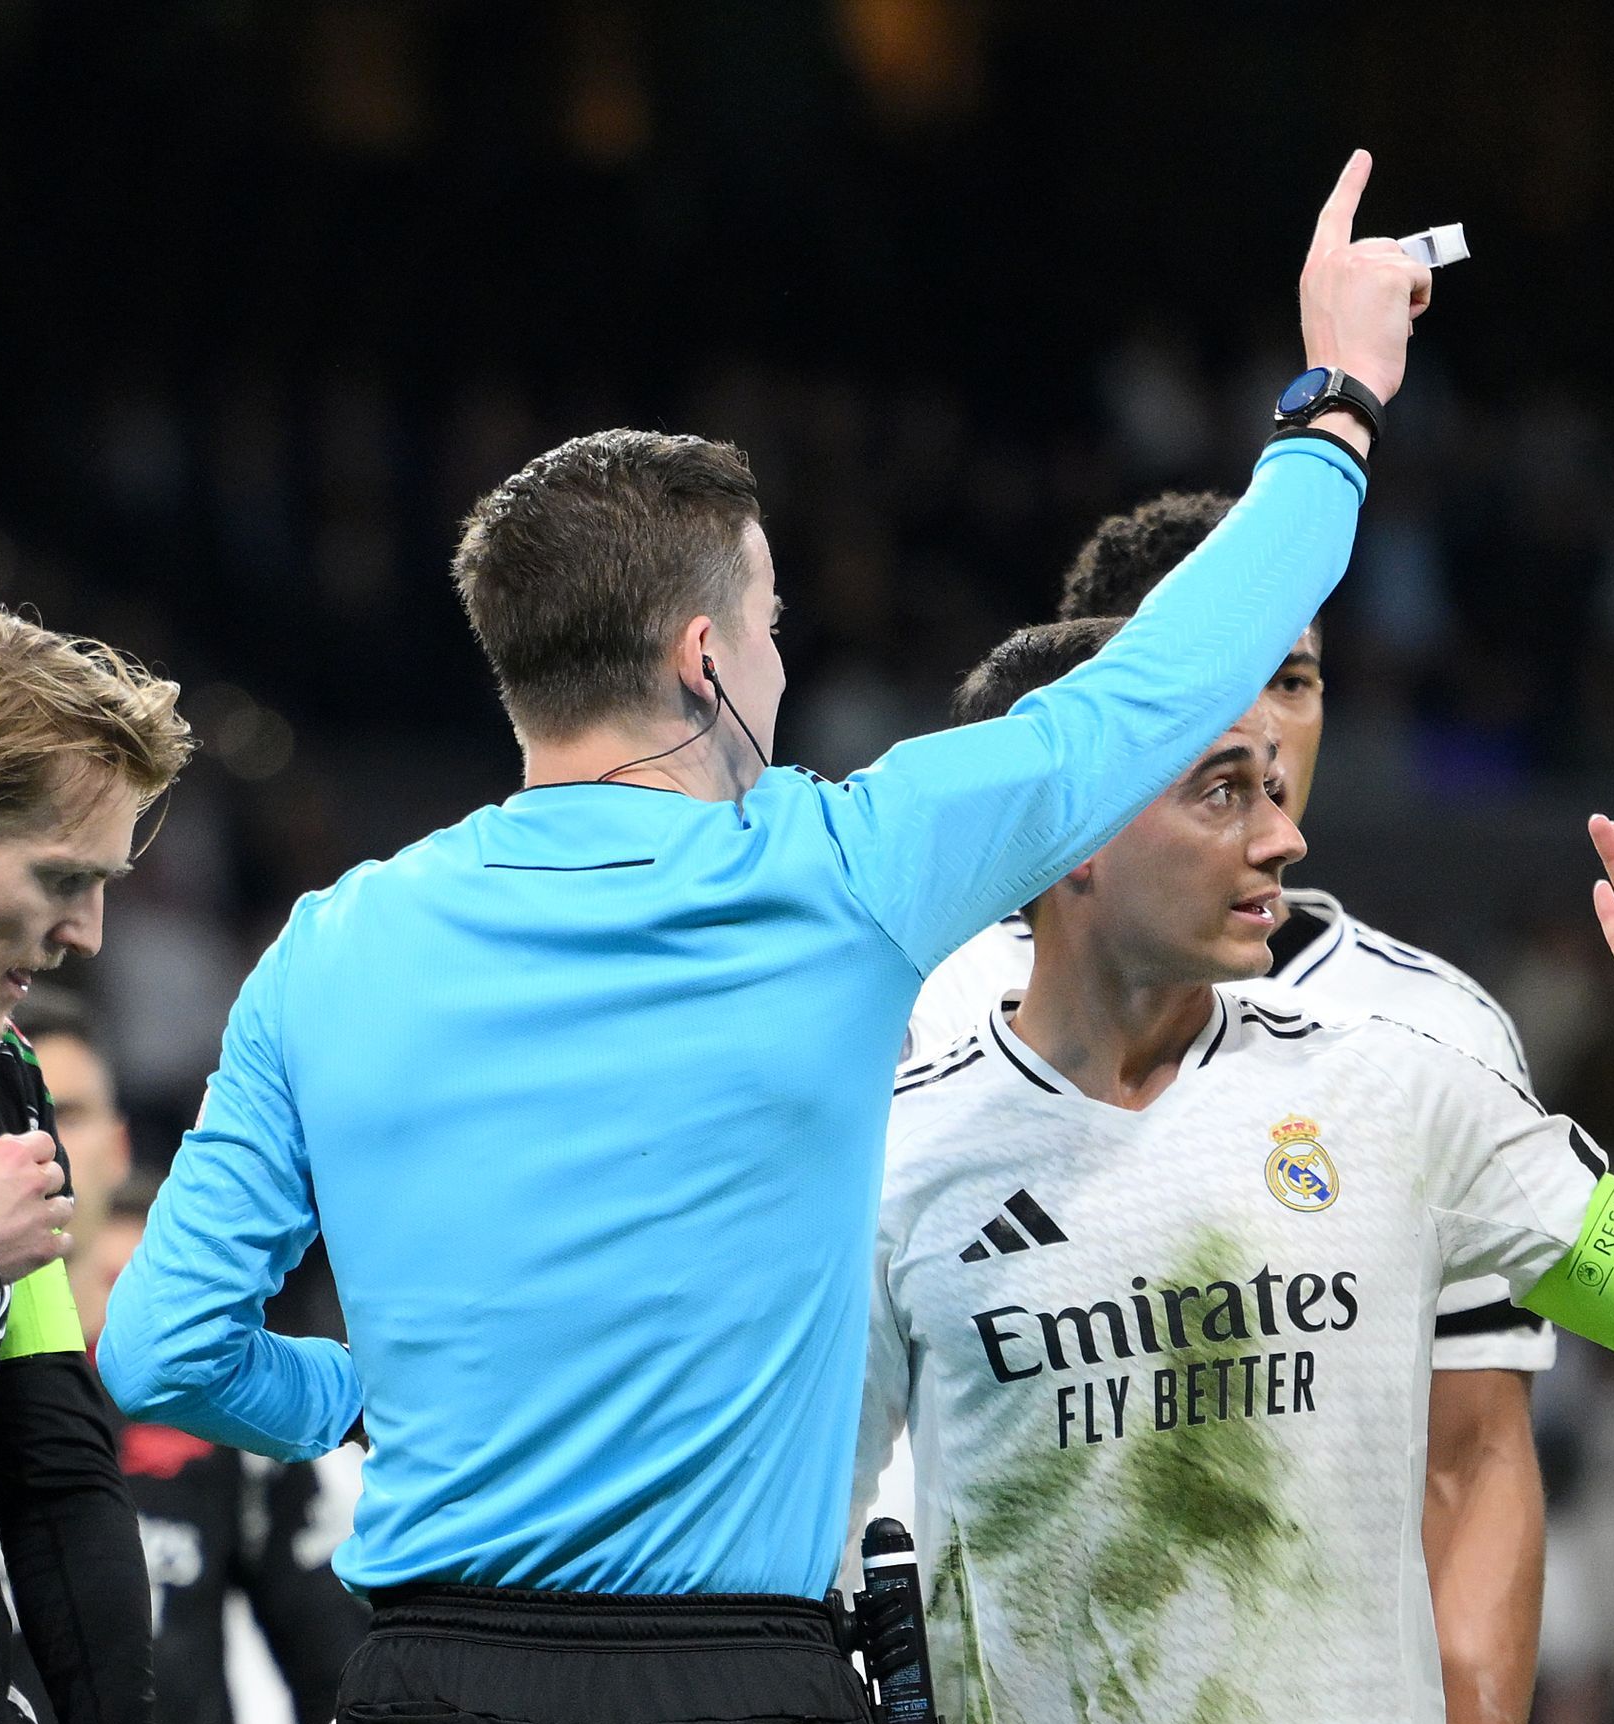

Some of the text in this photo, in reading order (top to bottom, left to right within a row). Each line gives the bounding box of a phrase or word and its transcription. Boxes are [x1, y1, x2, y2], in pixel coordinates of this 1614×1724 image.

[971, 1263, 1359, 1384] Emirates
[1057, 1350, 1317, 1449] FLY BETTER
